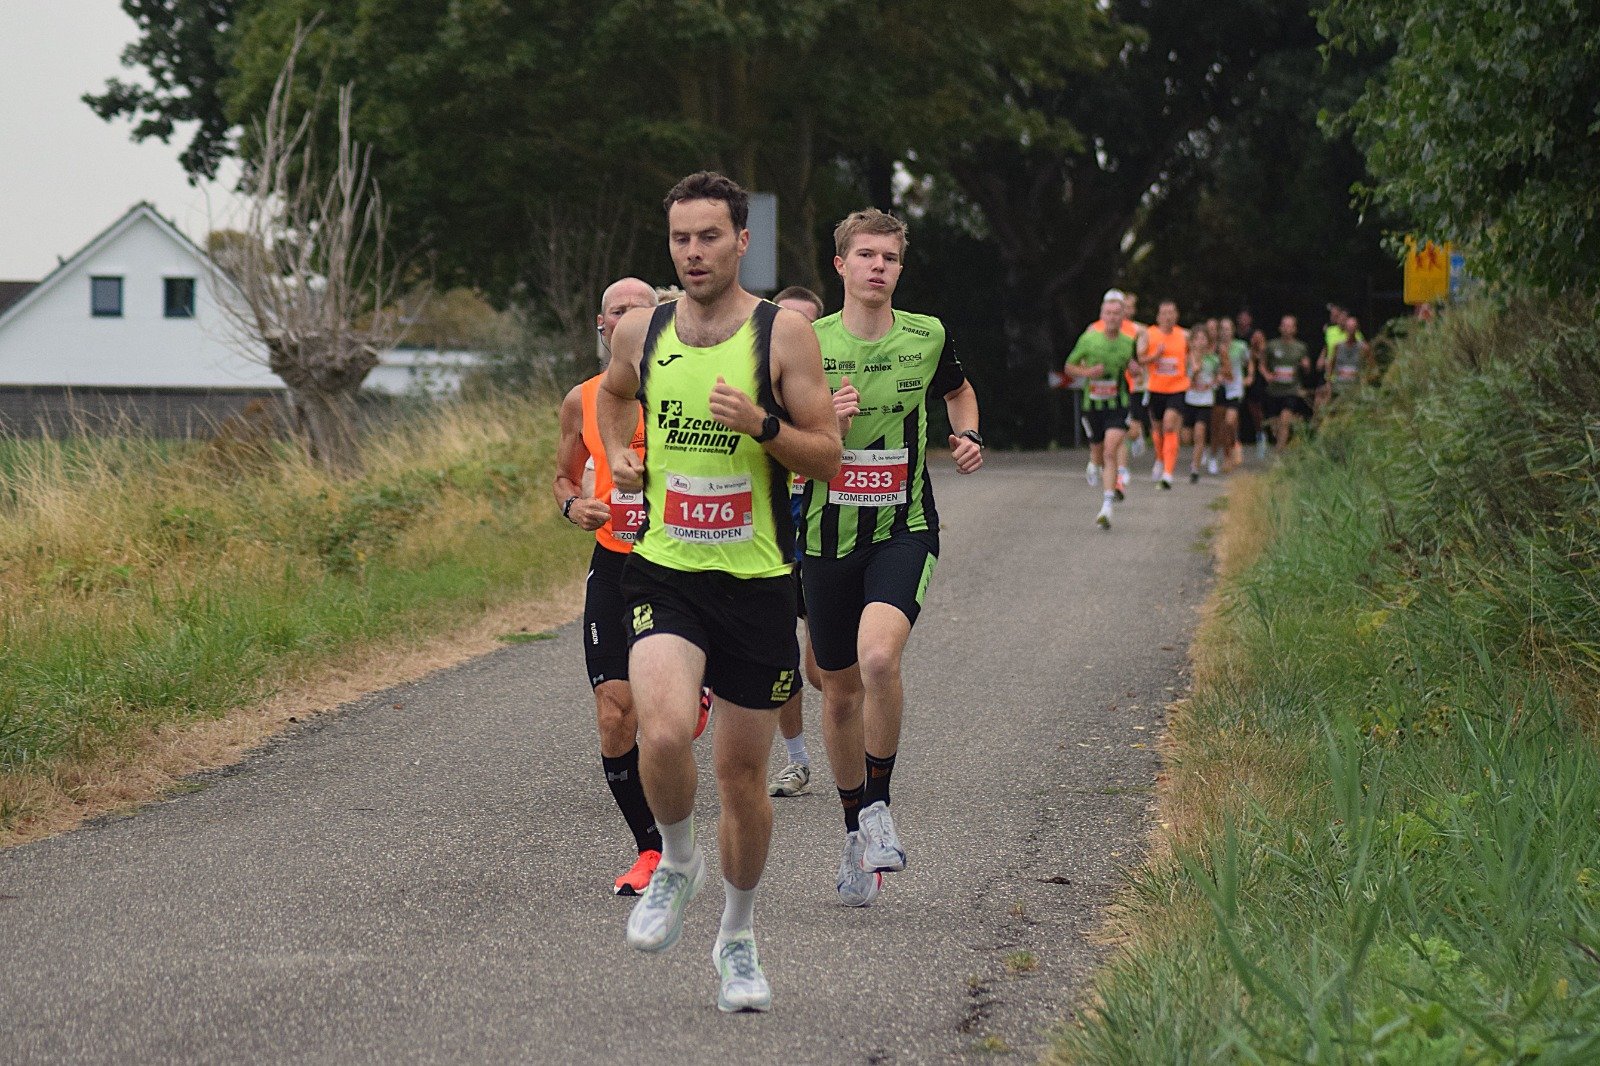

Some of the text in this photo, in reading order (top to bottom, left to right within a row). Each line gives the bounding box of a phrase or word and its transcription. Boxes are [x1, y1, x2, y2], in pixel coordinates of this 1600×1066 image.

[864, 364, 892, 373] Athlex
[666, 430, 741, 455] Running
[699, 447, 728, 455] coaching
[844, 471, 893, 488] 2533
[838, 493, 898, 502] ZOMERLOPEN
[626, 510, 646, 527] 25
[680, 502, 734, 523] 1476
[672, 527, 742, 539] ZOMERLOPEN
